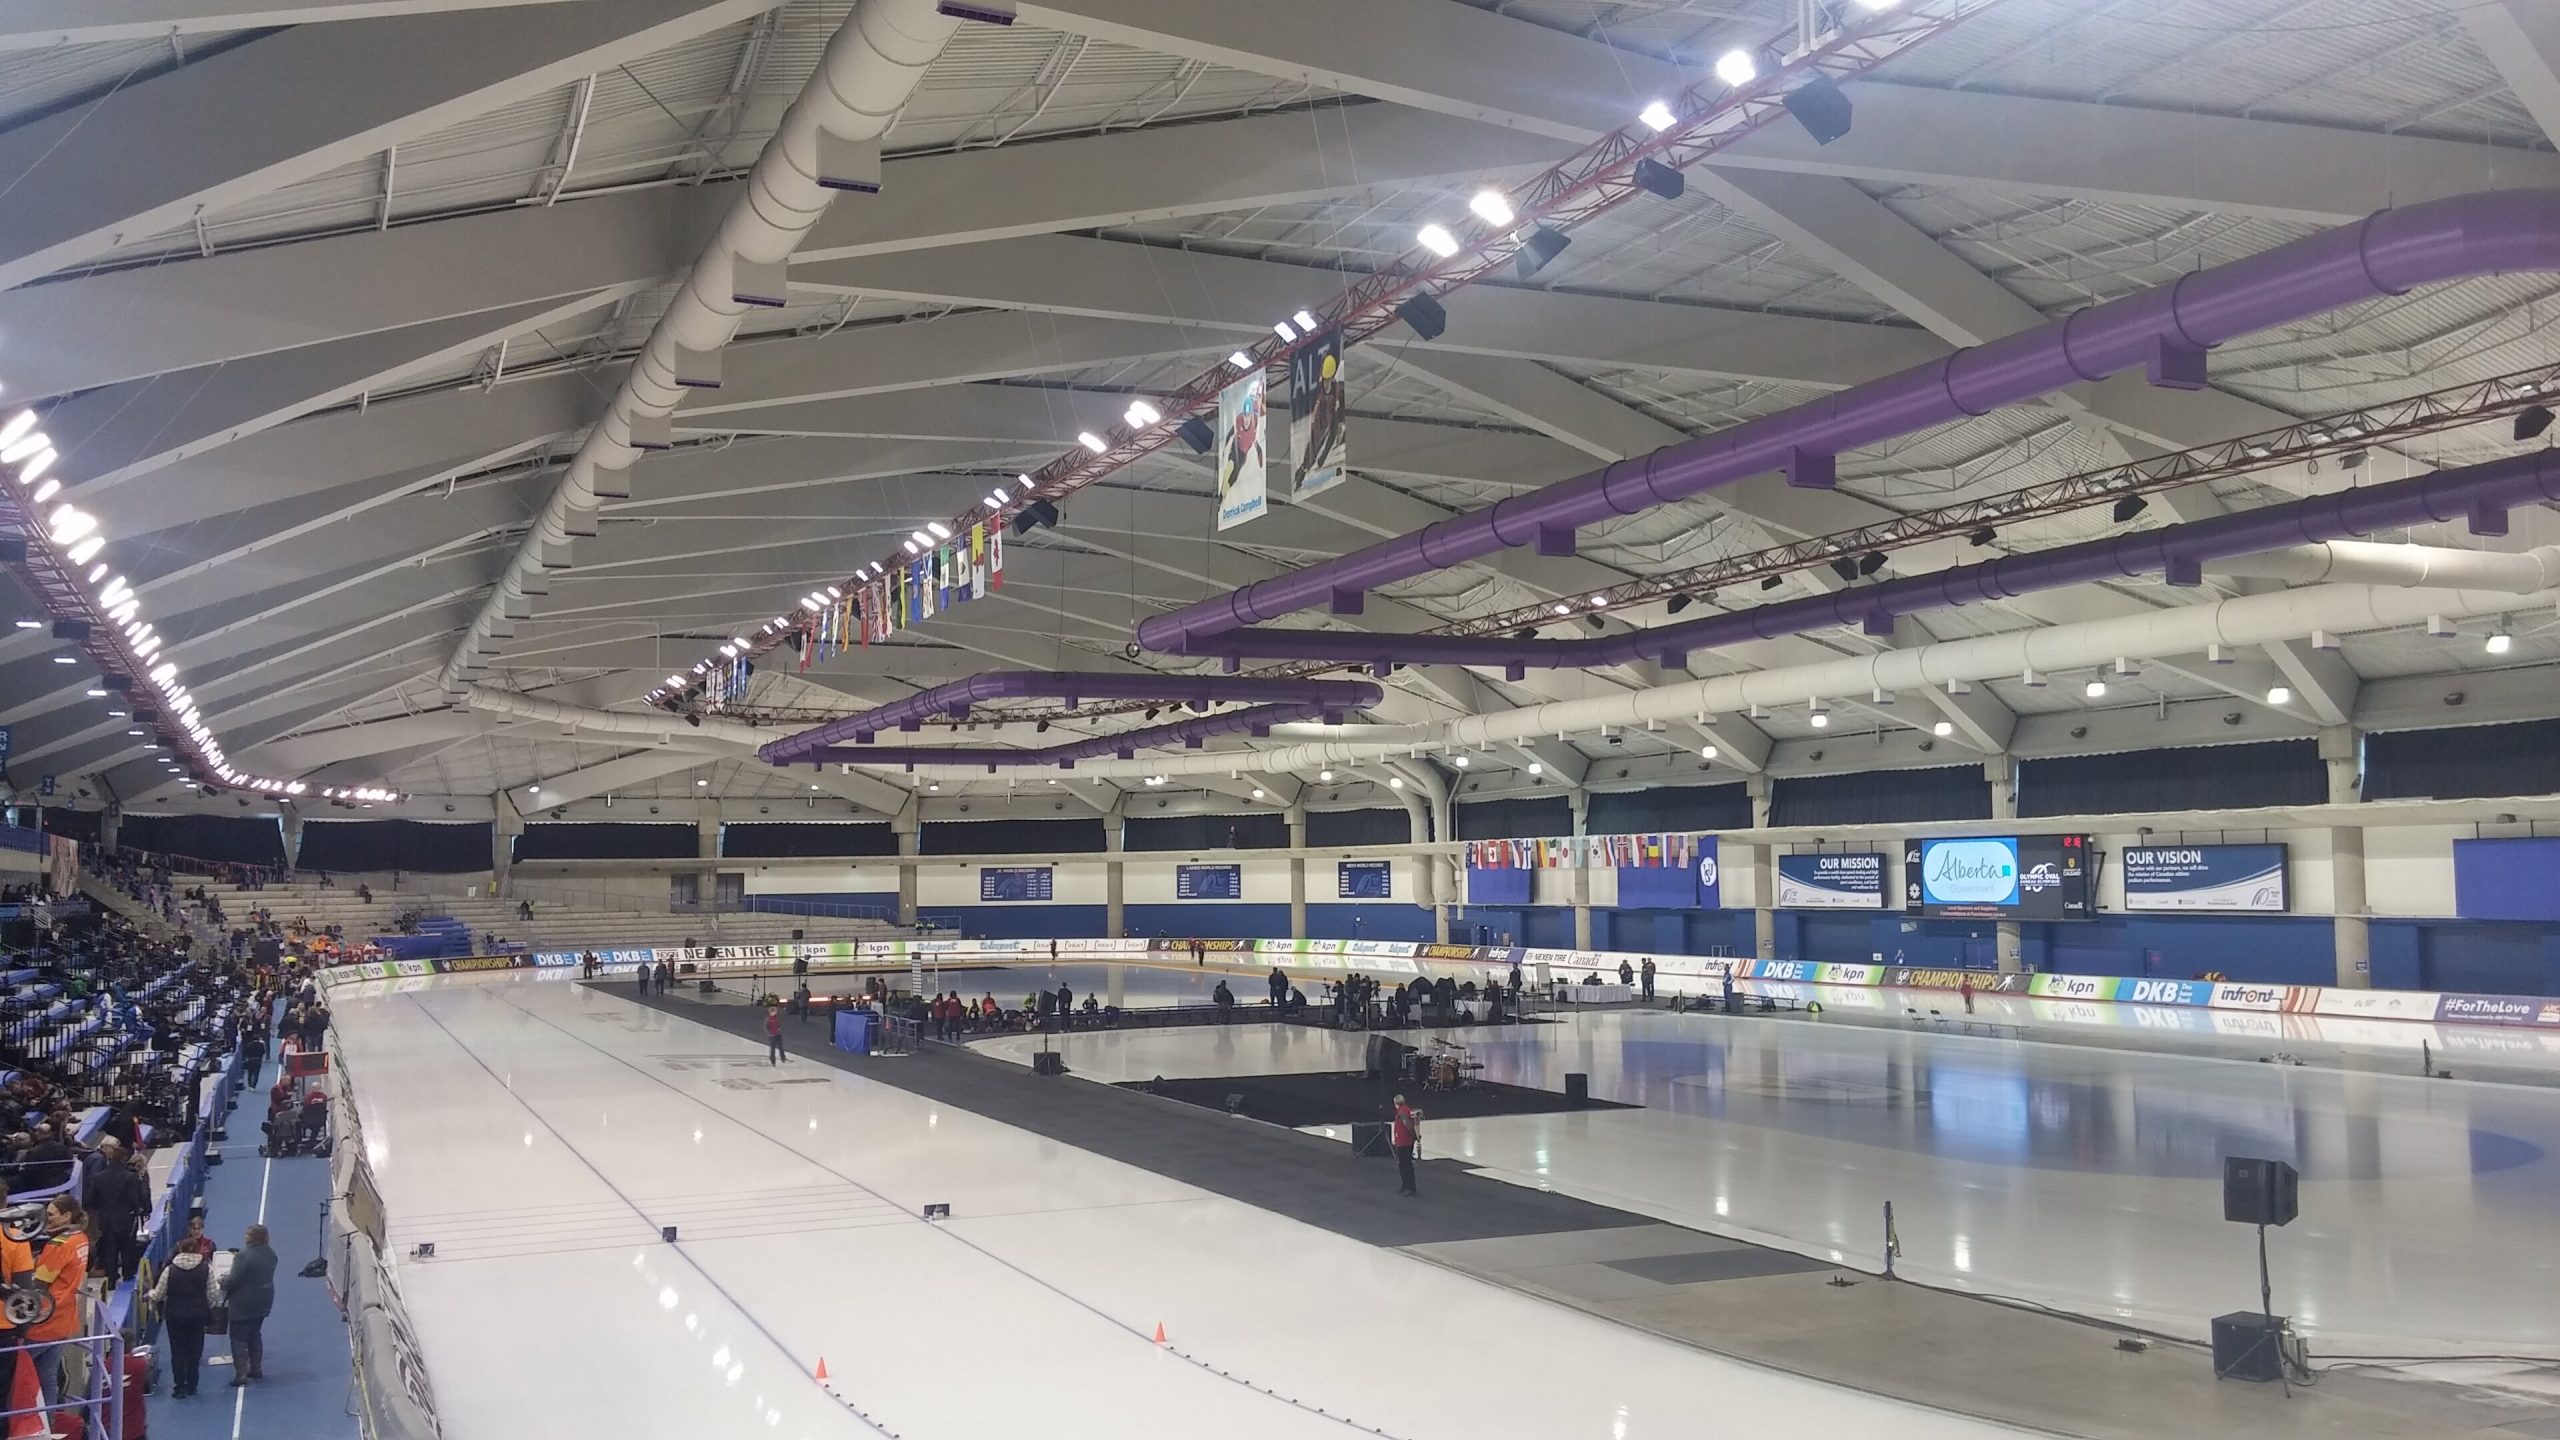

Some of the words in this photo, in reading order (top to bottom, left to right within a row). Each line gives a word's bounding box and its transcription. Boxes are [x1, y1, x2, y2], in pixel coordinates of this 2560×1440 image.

[1820, 858, 1839, 869] OUR
[1841, 857, 1879, 869] MISSION
[2126, 852, 2154, 864] OUR
[2156, 851, 2201, 864] VISION
[1931, 850, 2004, 882] Alberta
[684, 946, 736, 959] NEEN
[739, 945, 776, 957] TIRE
[806, 946, 826, 954] kpn
[870, 944, 890, 952] kpn
[1276, 941, 1292, 950] kpn
[1322, 941, 1336, 951] kpn
[537, 953, 564, 966] DKB
[613, 950, 640, 963] DKB
[1568, 952, 1602, 967] Canada
[406, 963, 422, 973] kpn
[452, 957, 513, 971] CHAMPIONSHIPS
[1705, 959, 1733, 971] infrot
[1763, 961, 1794, 979] DKB
[370, 966, 383, 976] kpn
[1843, 967, 1864, 980] kpn
[2067, 979, 2094, 994] kpn
[2132, 981, 2178, 1002] DKB
[2221, 986, 2274, 1003] infront
[2445, 998, 2530, 1014] #ForTheLove
